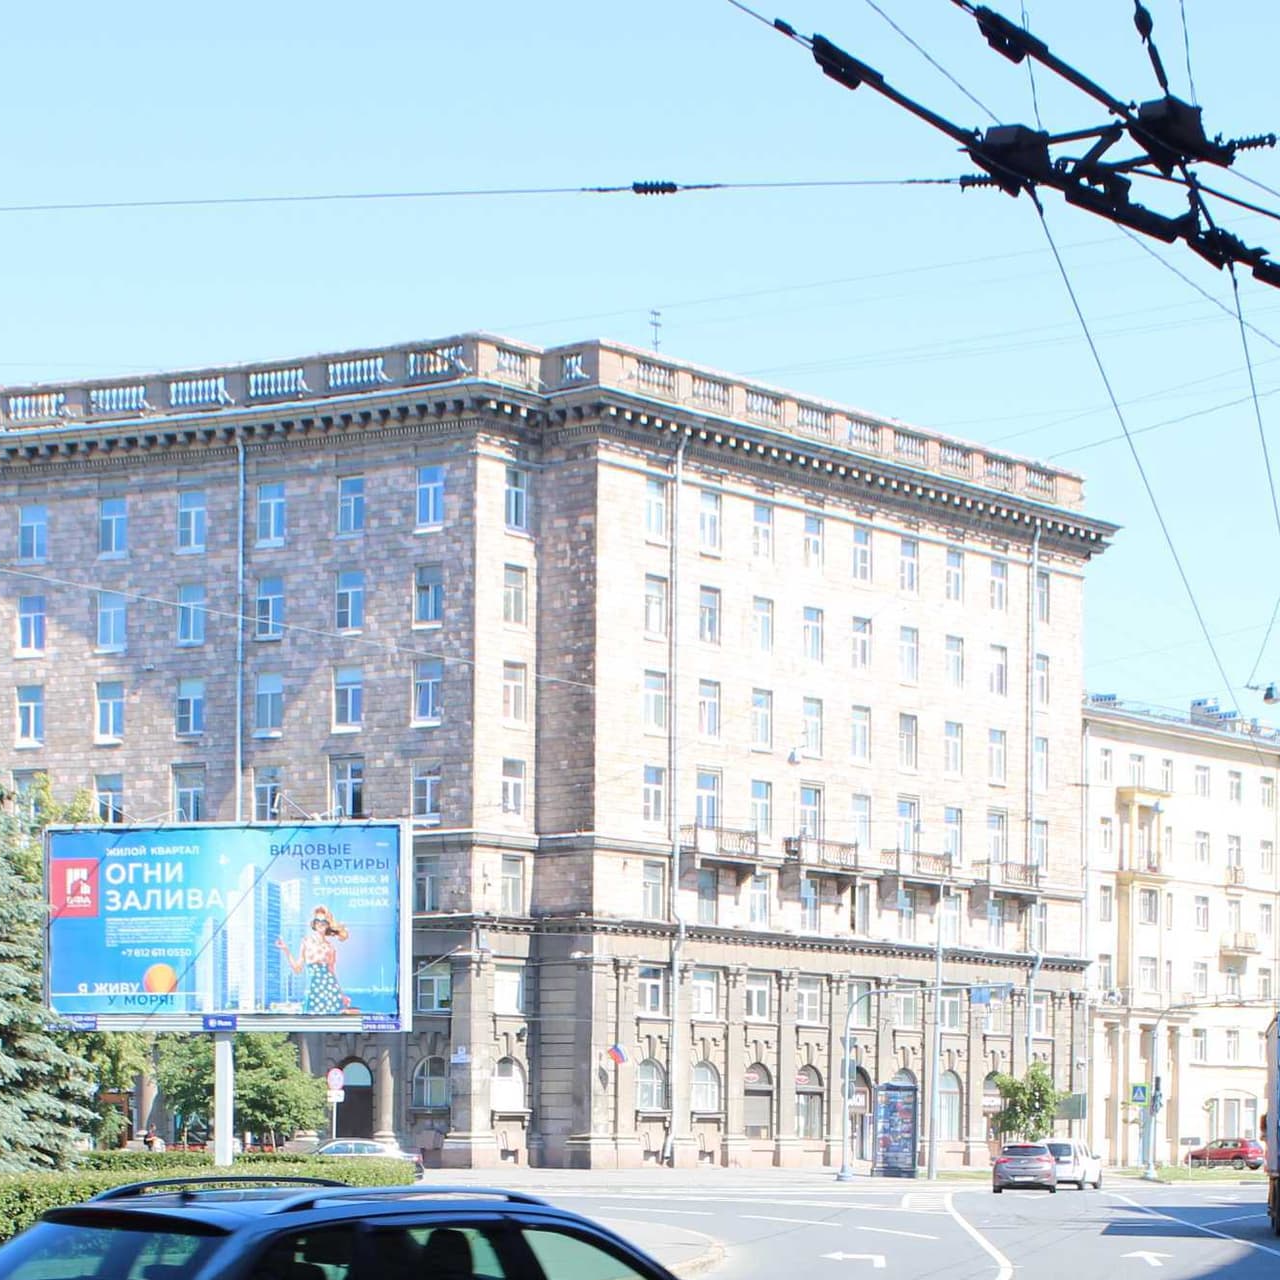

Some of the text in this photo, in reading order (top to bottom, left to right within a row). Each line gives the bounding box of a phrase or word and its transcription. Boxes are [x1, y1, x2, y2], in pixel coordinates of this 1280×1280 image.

[106, 845, 200, 856] ЖИЛОЙ КВАРТАЛ
[270, 843, 352, 858] ВИДОВЫЕ
[300, 858, 390, 871] КВАРТИРЫ
[105, 862, 184, 885] ОГНИ
[105, 889, 225, 912] ЗАЛИВА
[94, 982, 140, 994] ЖИВУ
[124, 995, 174, 1006] МОРЯ!
